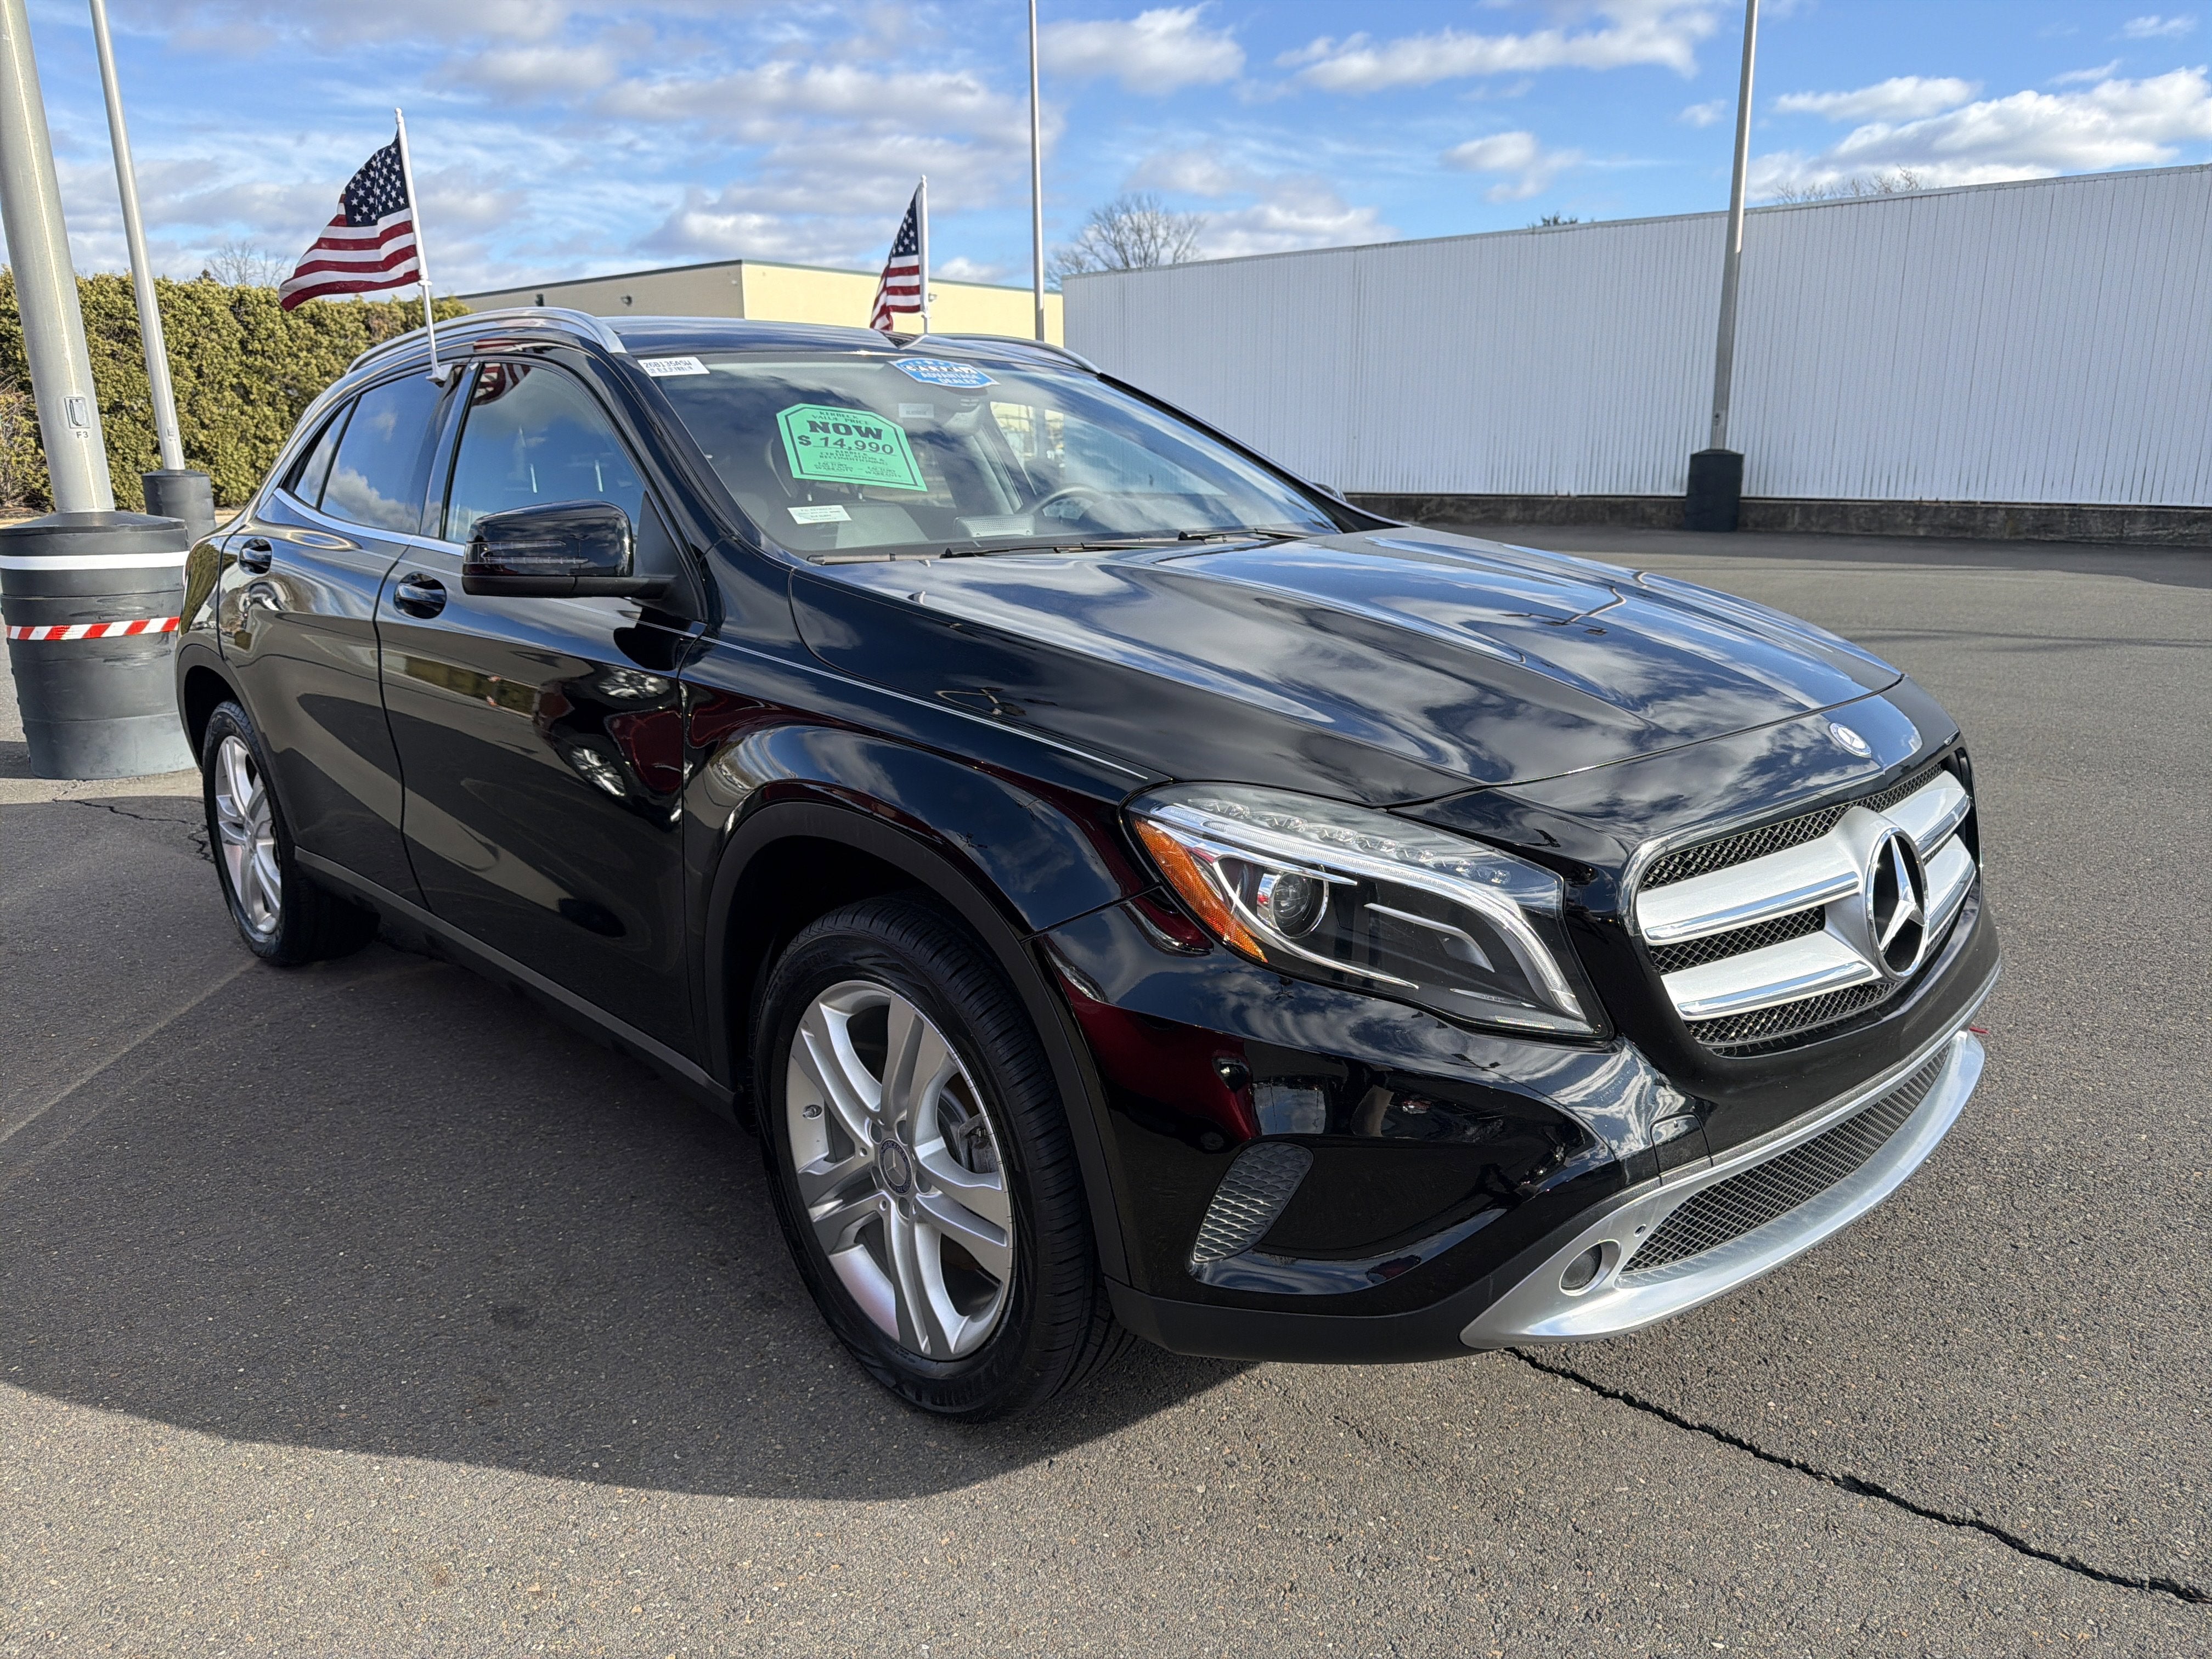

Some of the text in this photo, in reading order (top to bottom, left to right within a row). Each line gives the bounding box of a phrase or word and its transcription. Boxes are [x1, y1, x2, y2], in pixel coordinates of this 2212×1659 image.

[820, 411, 859, 420] KERBECK
[807, 420, 883, 440] NOW
[797, 435, 894, 455] $ 14,990
